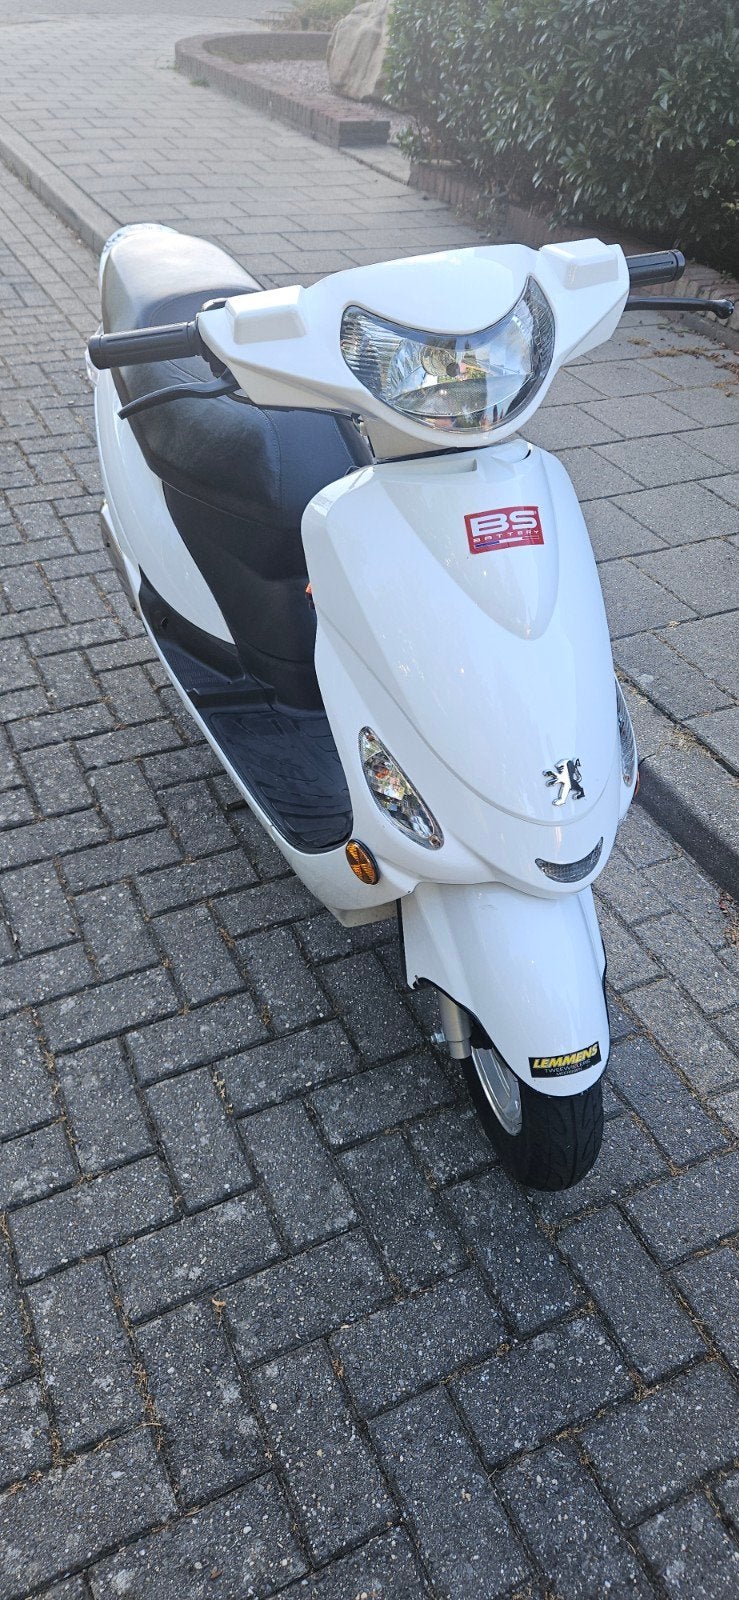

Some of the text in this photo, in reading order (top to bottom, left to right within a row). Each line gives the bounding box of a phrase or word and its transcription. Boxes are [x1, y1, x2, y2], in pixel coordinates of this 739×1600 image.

[470, 511, 537, 537] BS
[473, 530, 539, 543] BATTERY
[533, 1044, 598, 1069] LEMMENS
